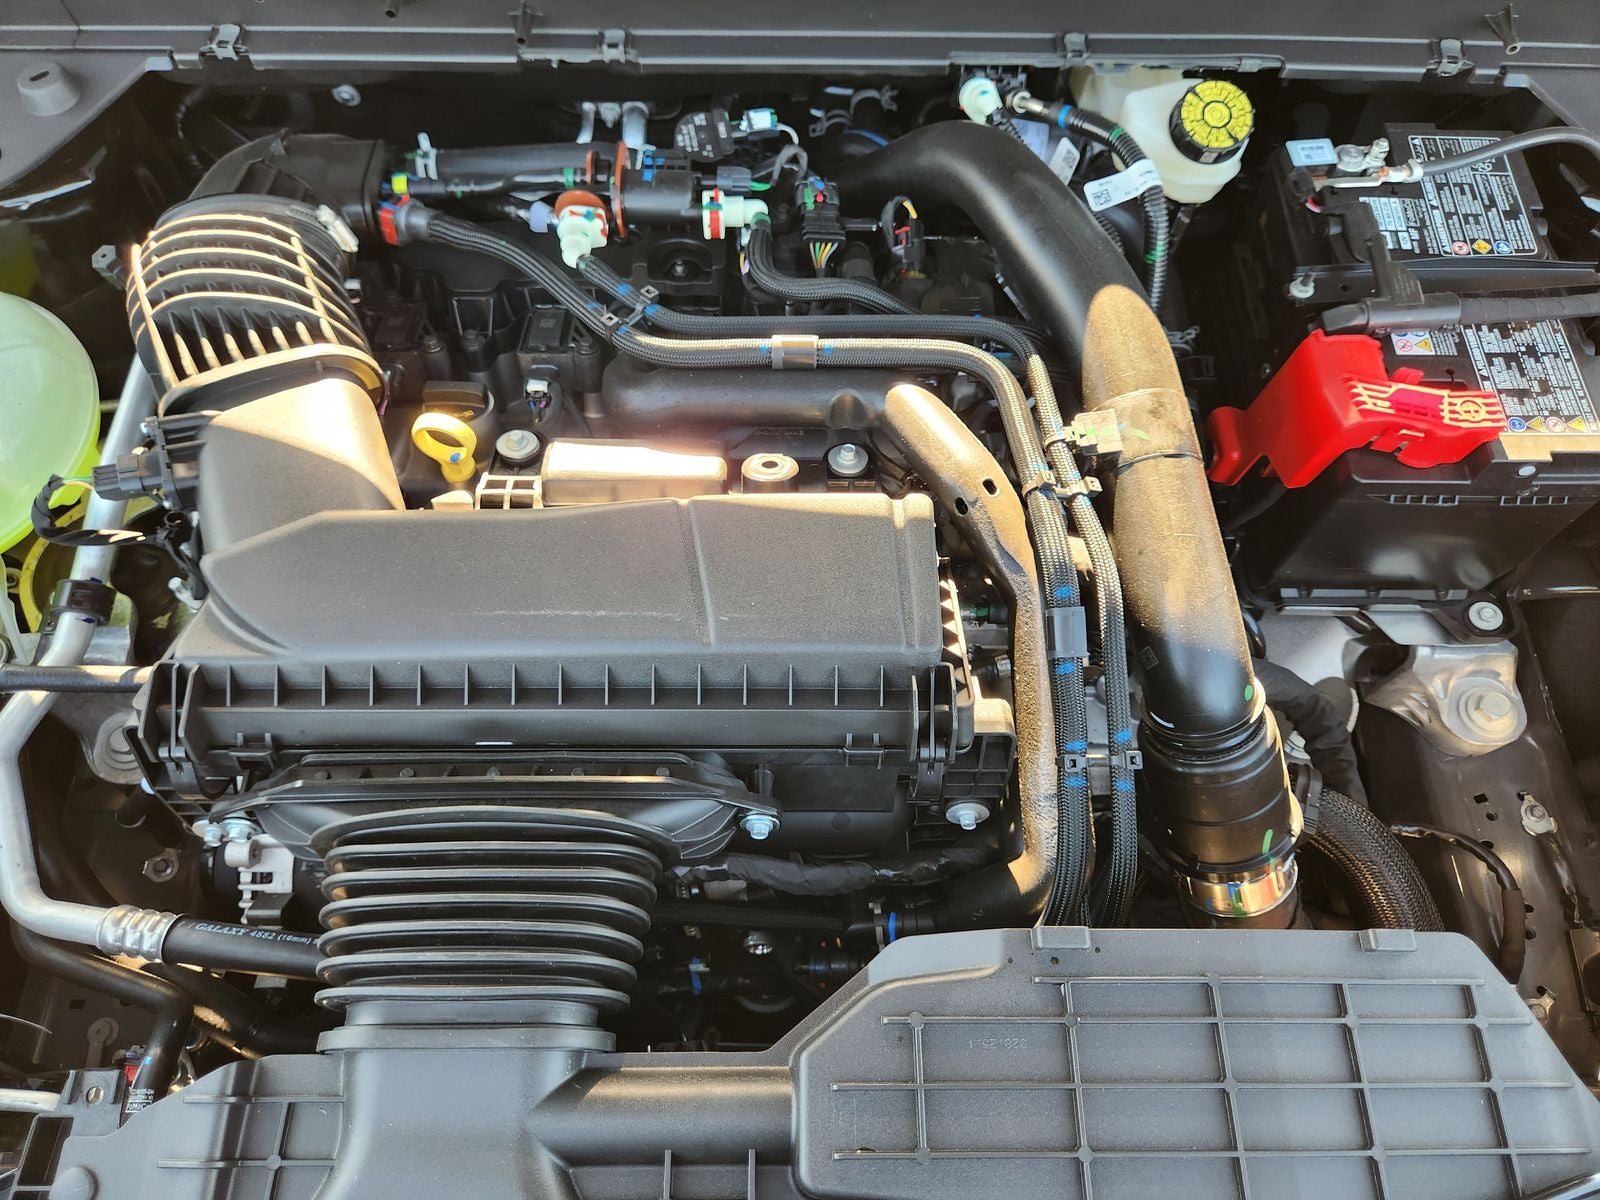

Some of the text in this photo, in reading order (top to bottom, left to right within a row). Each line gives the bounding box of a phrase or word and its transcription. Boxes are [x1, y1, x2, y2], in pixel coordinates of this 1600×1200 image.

[1401, 200, 1417, 224] FoMoCo
[195, 922, 249, 936] GALAXY
[249, 930, 276, 940] 4882
